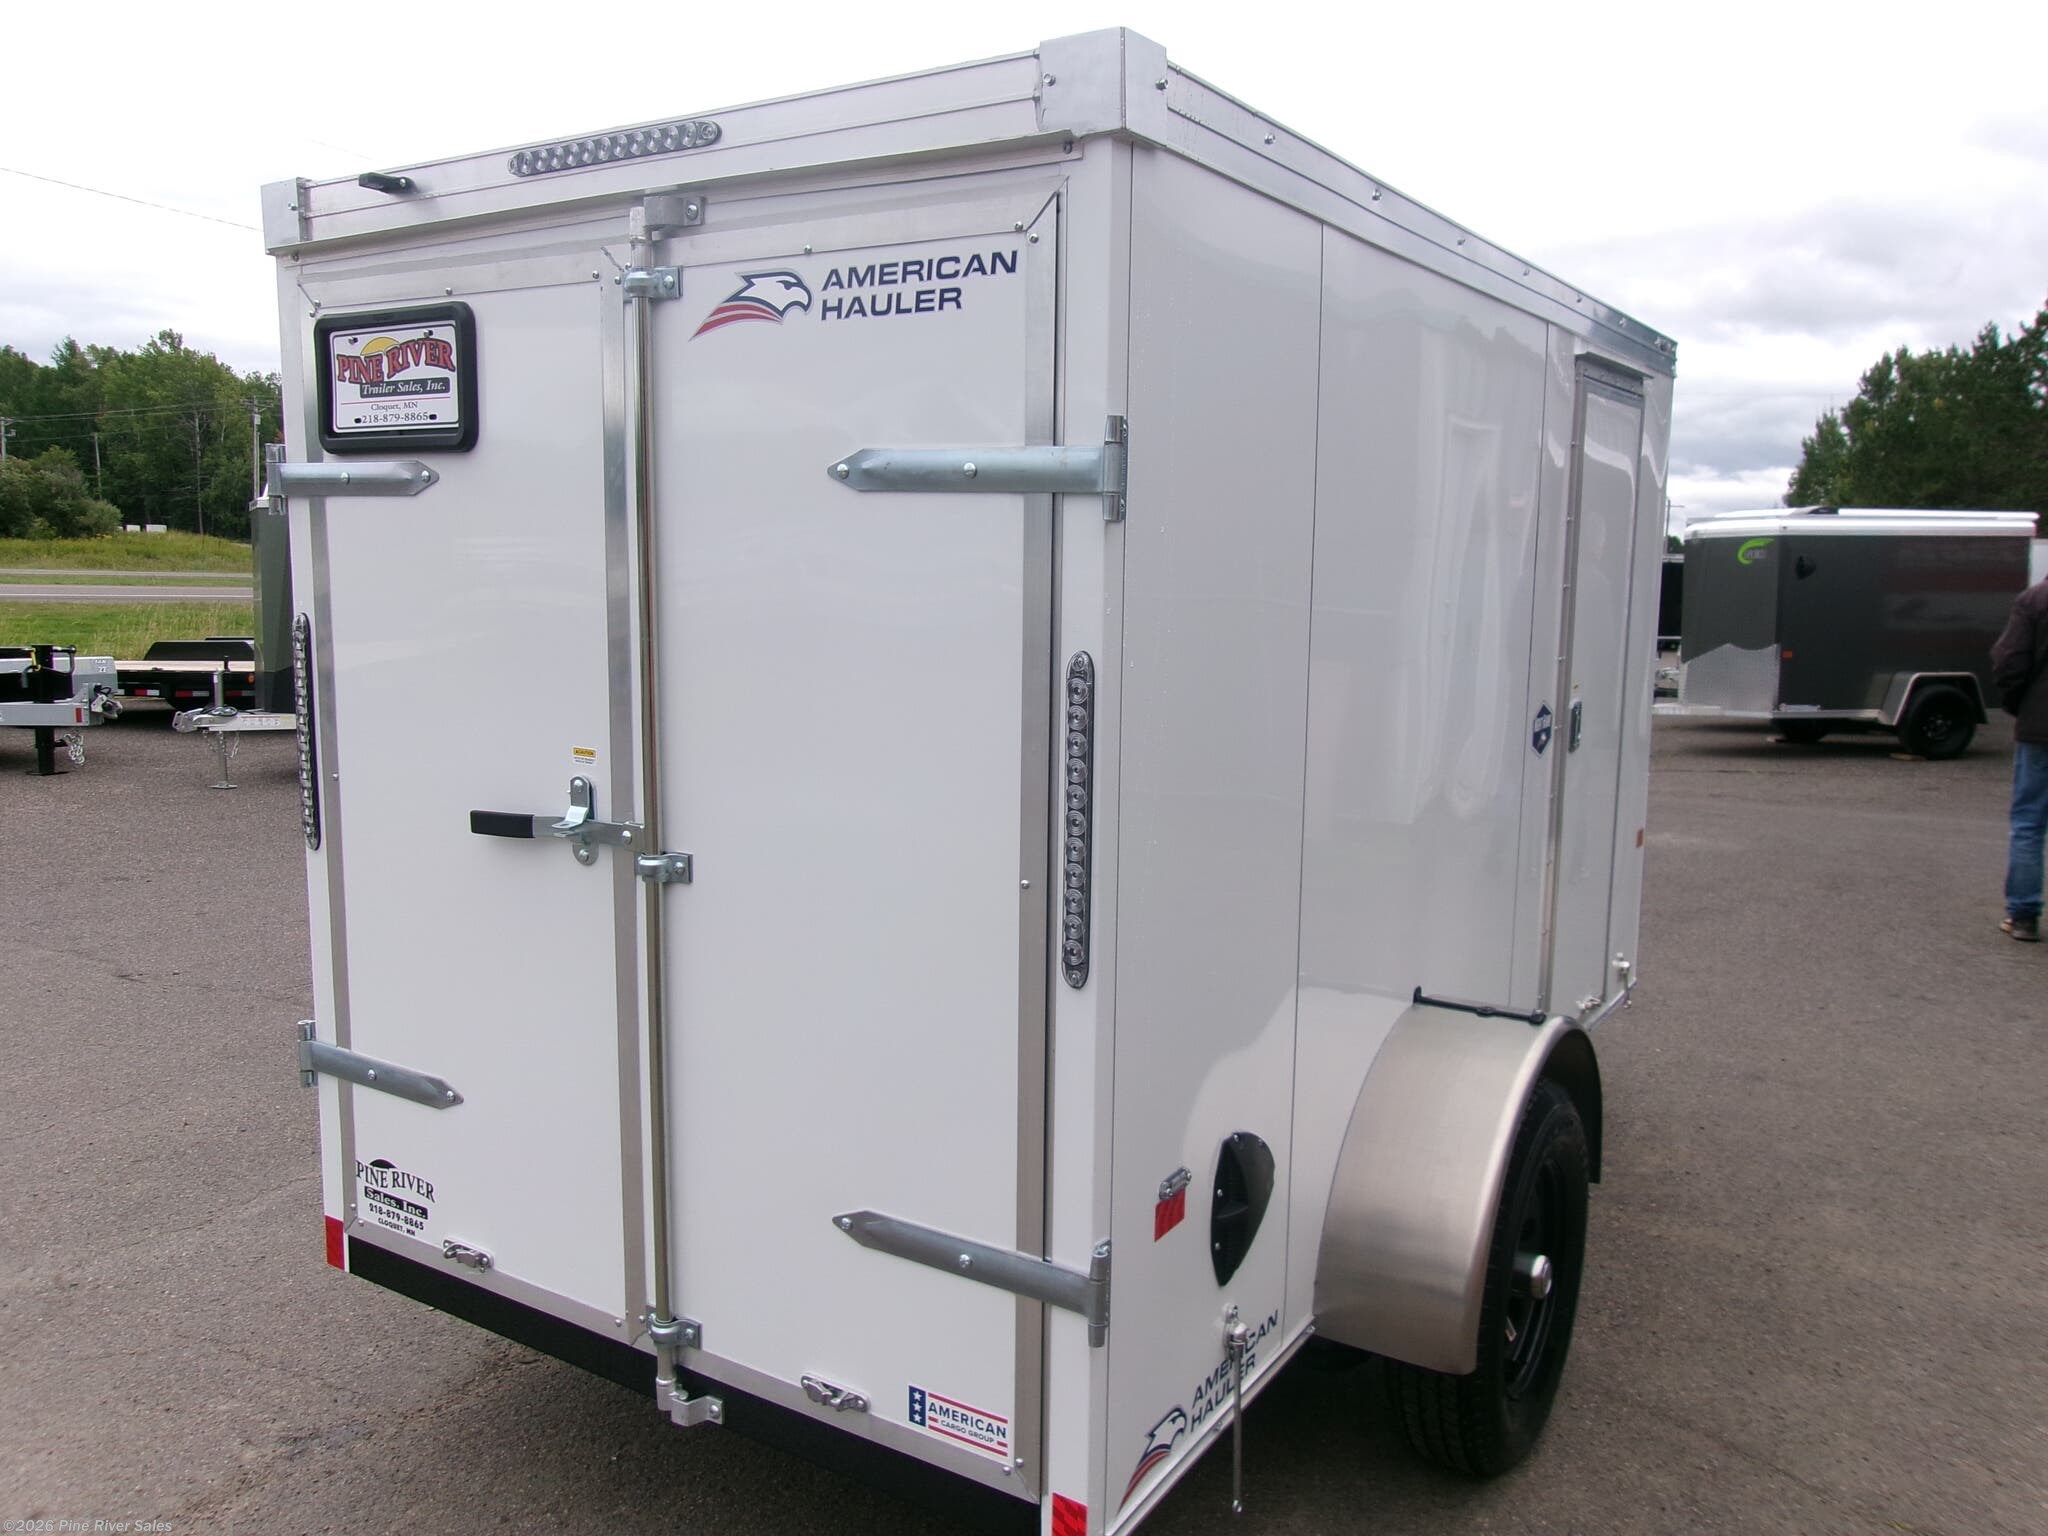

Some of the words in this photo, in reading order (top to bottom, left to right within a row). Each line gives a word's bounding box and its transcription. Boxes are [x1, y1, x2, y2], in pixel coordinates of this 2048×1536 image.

[822, 250, 1018, 291] AMERICAN
[821, 287, 963, 321] HAULER
[336, 353, 384, 384] PINE
[386, 337, 456, 379] RIVER
[362, 384, 395, 395] Trailer
[397, 381, 423, 392] Sales,
[426, 380, 446, 391] Inc.
[362, 412, 429, 424] 218-879-8865
[370, 402, 402, 411] Cloquet,
[403, 401, 418, 409] MN
[355, 1160, 389, 1189] PINE
[392, 1171, 436, 1203] RIVER
[369, 1203, 424, 1230] 218-879-8865
[402, 1201, 426, 1218] Inc.
[928, 1402, 1006, 1439] AMERICAN
[941, 1420, 966, 1434] CARGO
[968, 1430, 994, 1444] GROUP
